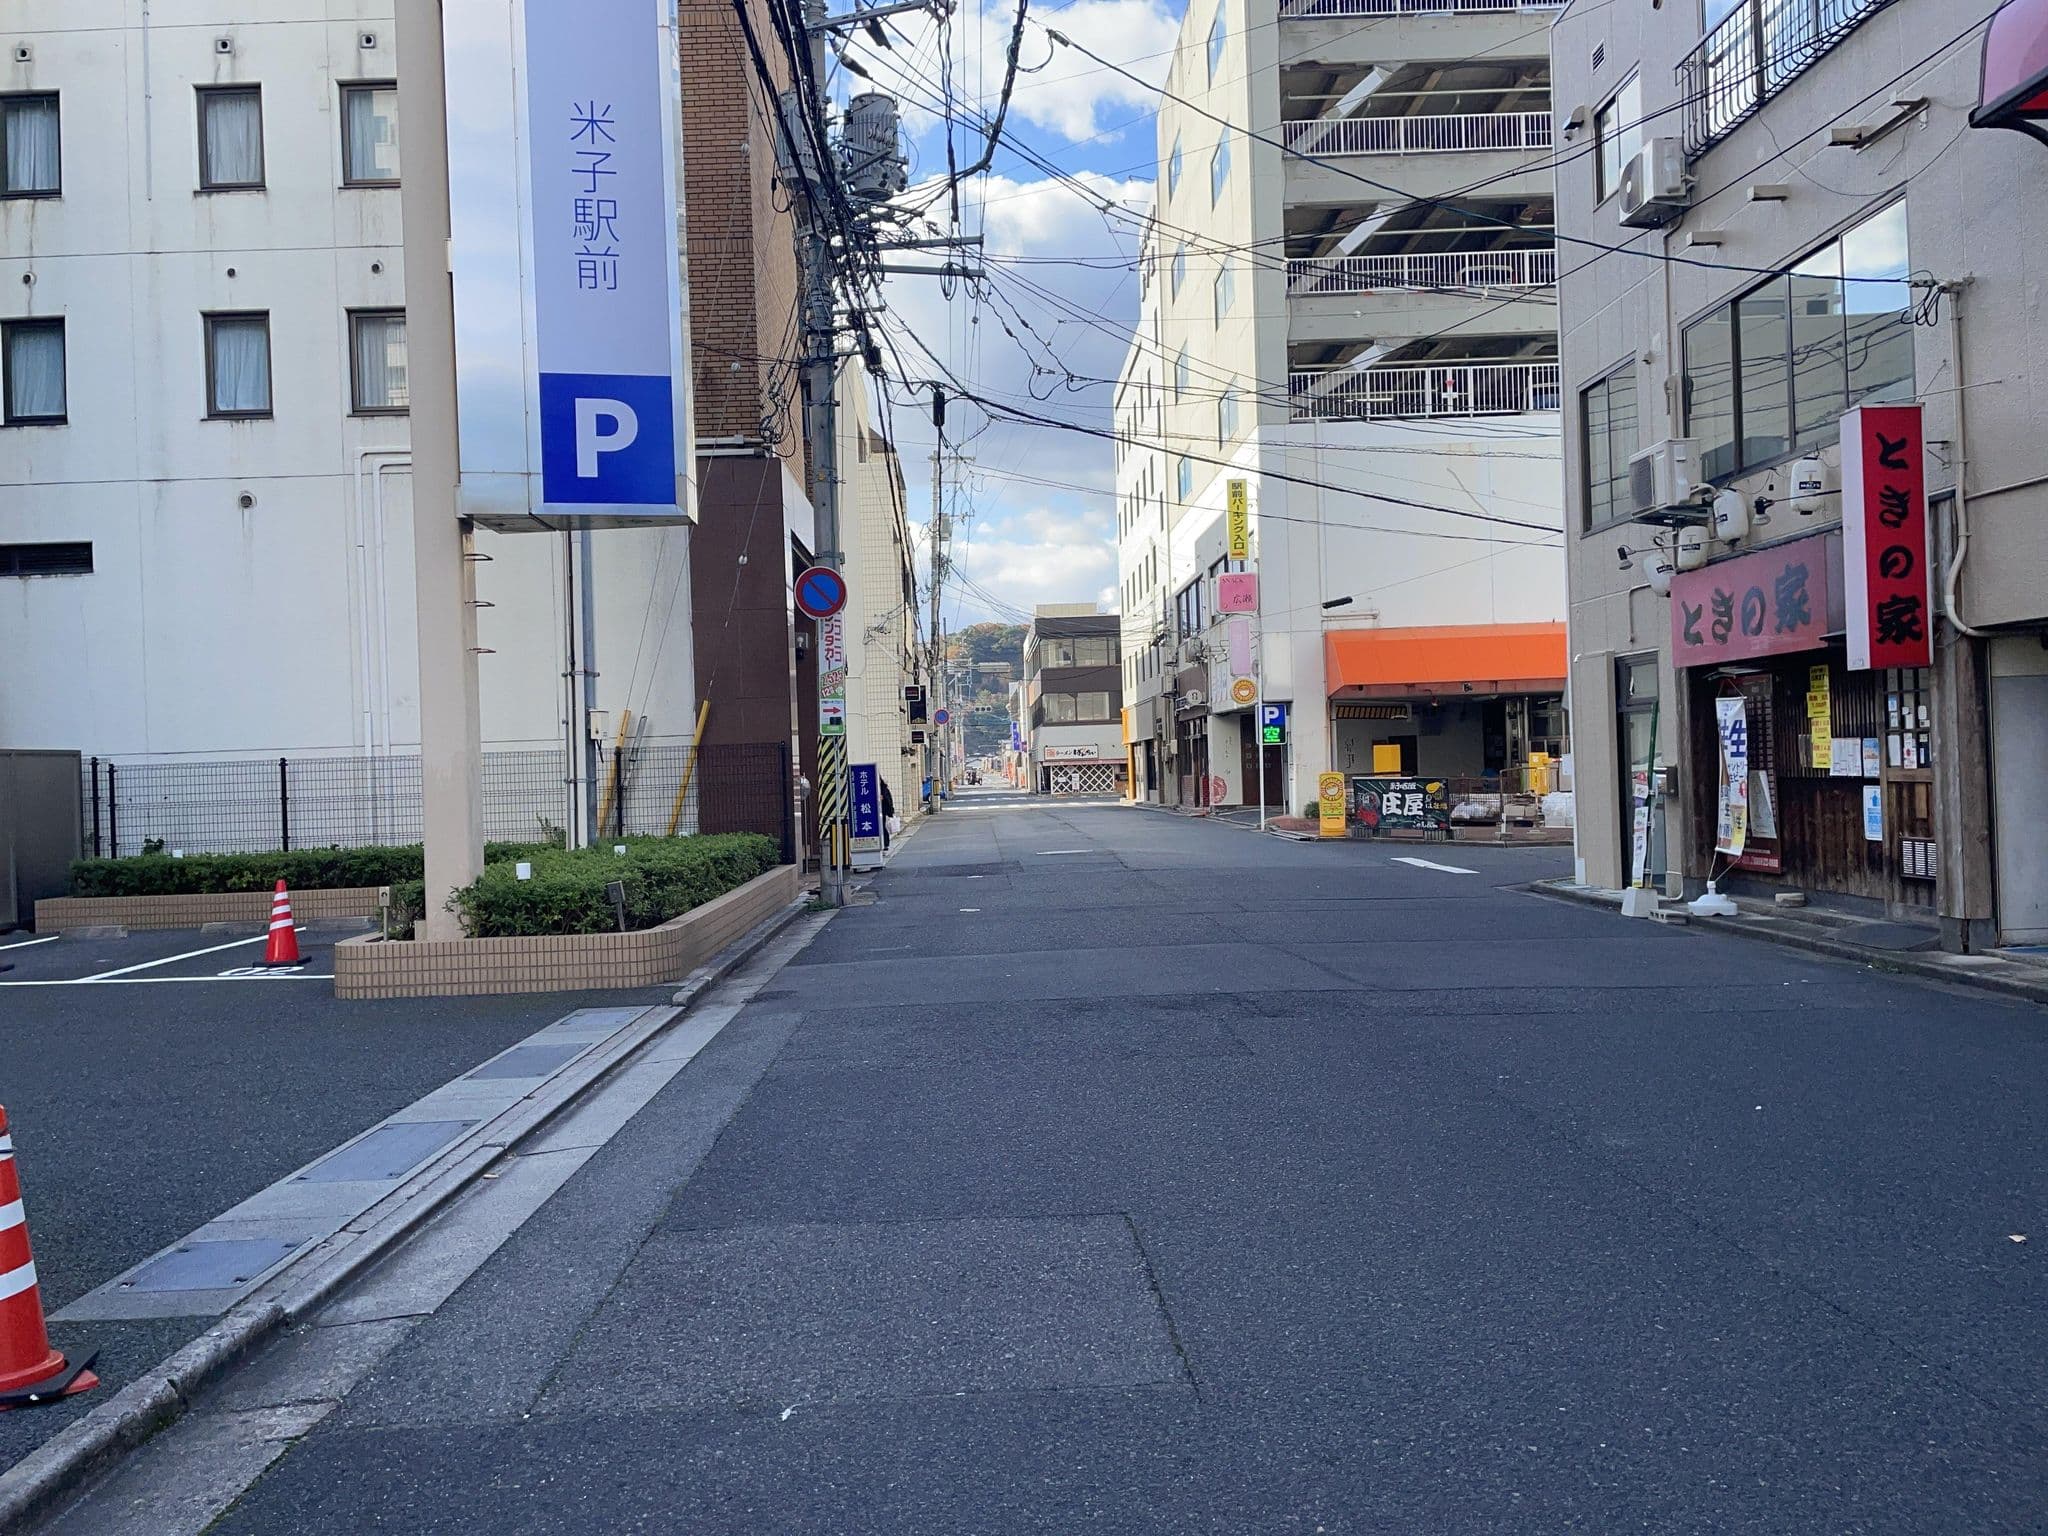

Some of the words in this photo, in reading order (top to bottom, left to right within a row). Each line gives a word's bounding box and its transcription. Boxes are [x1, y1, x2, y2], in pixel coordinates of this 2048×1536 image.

[569, 99, 620, 291] 米子駅前
[574, 396, 639, 479] P
[1231, 482, 1245, 550] 駅前パーキング入口
[1875, 431, 1924, 646] ときの家
[1680, 560, 1812, 646] ときの家
[1264, 706, 1280, 725] P
